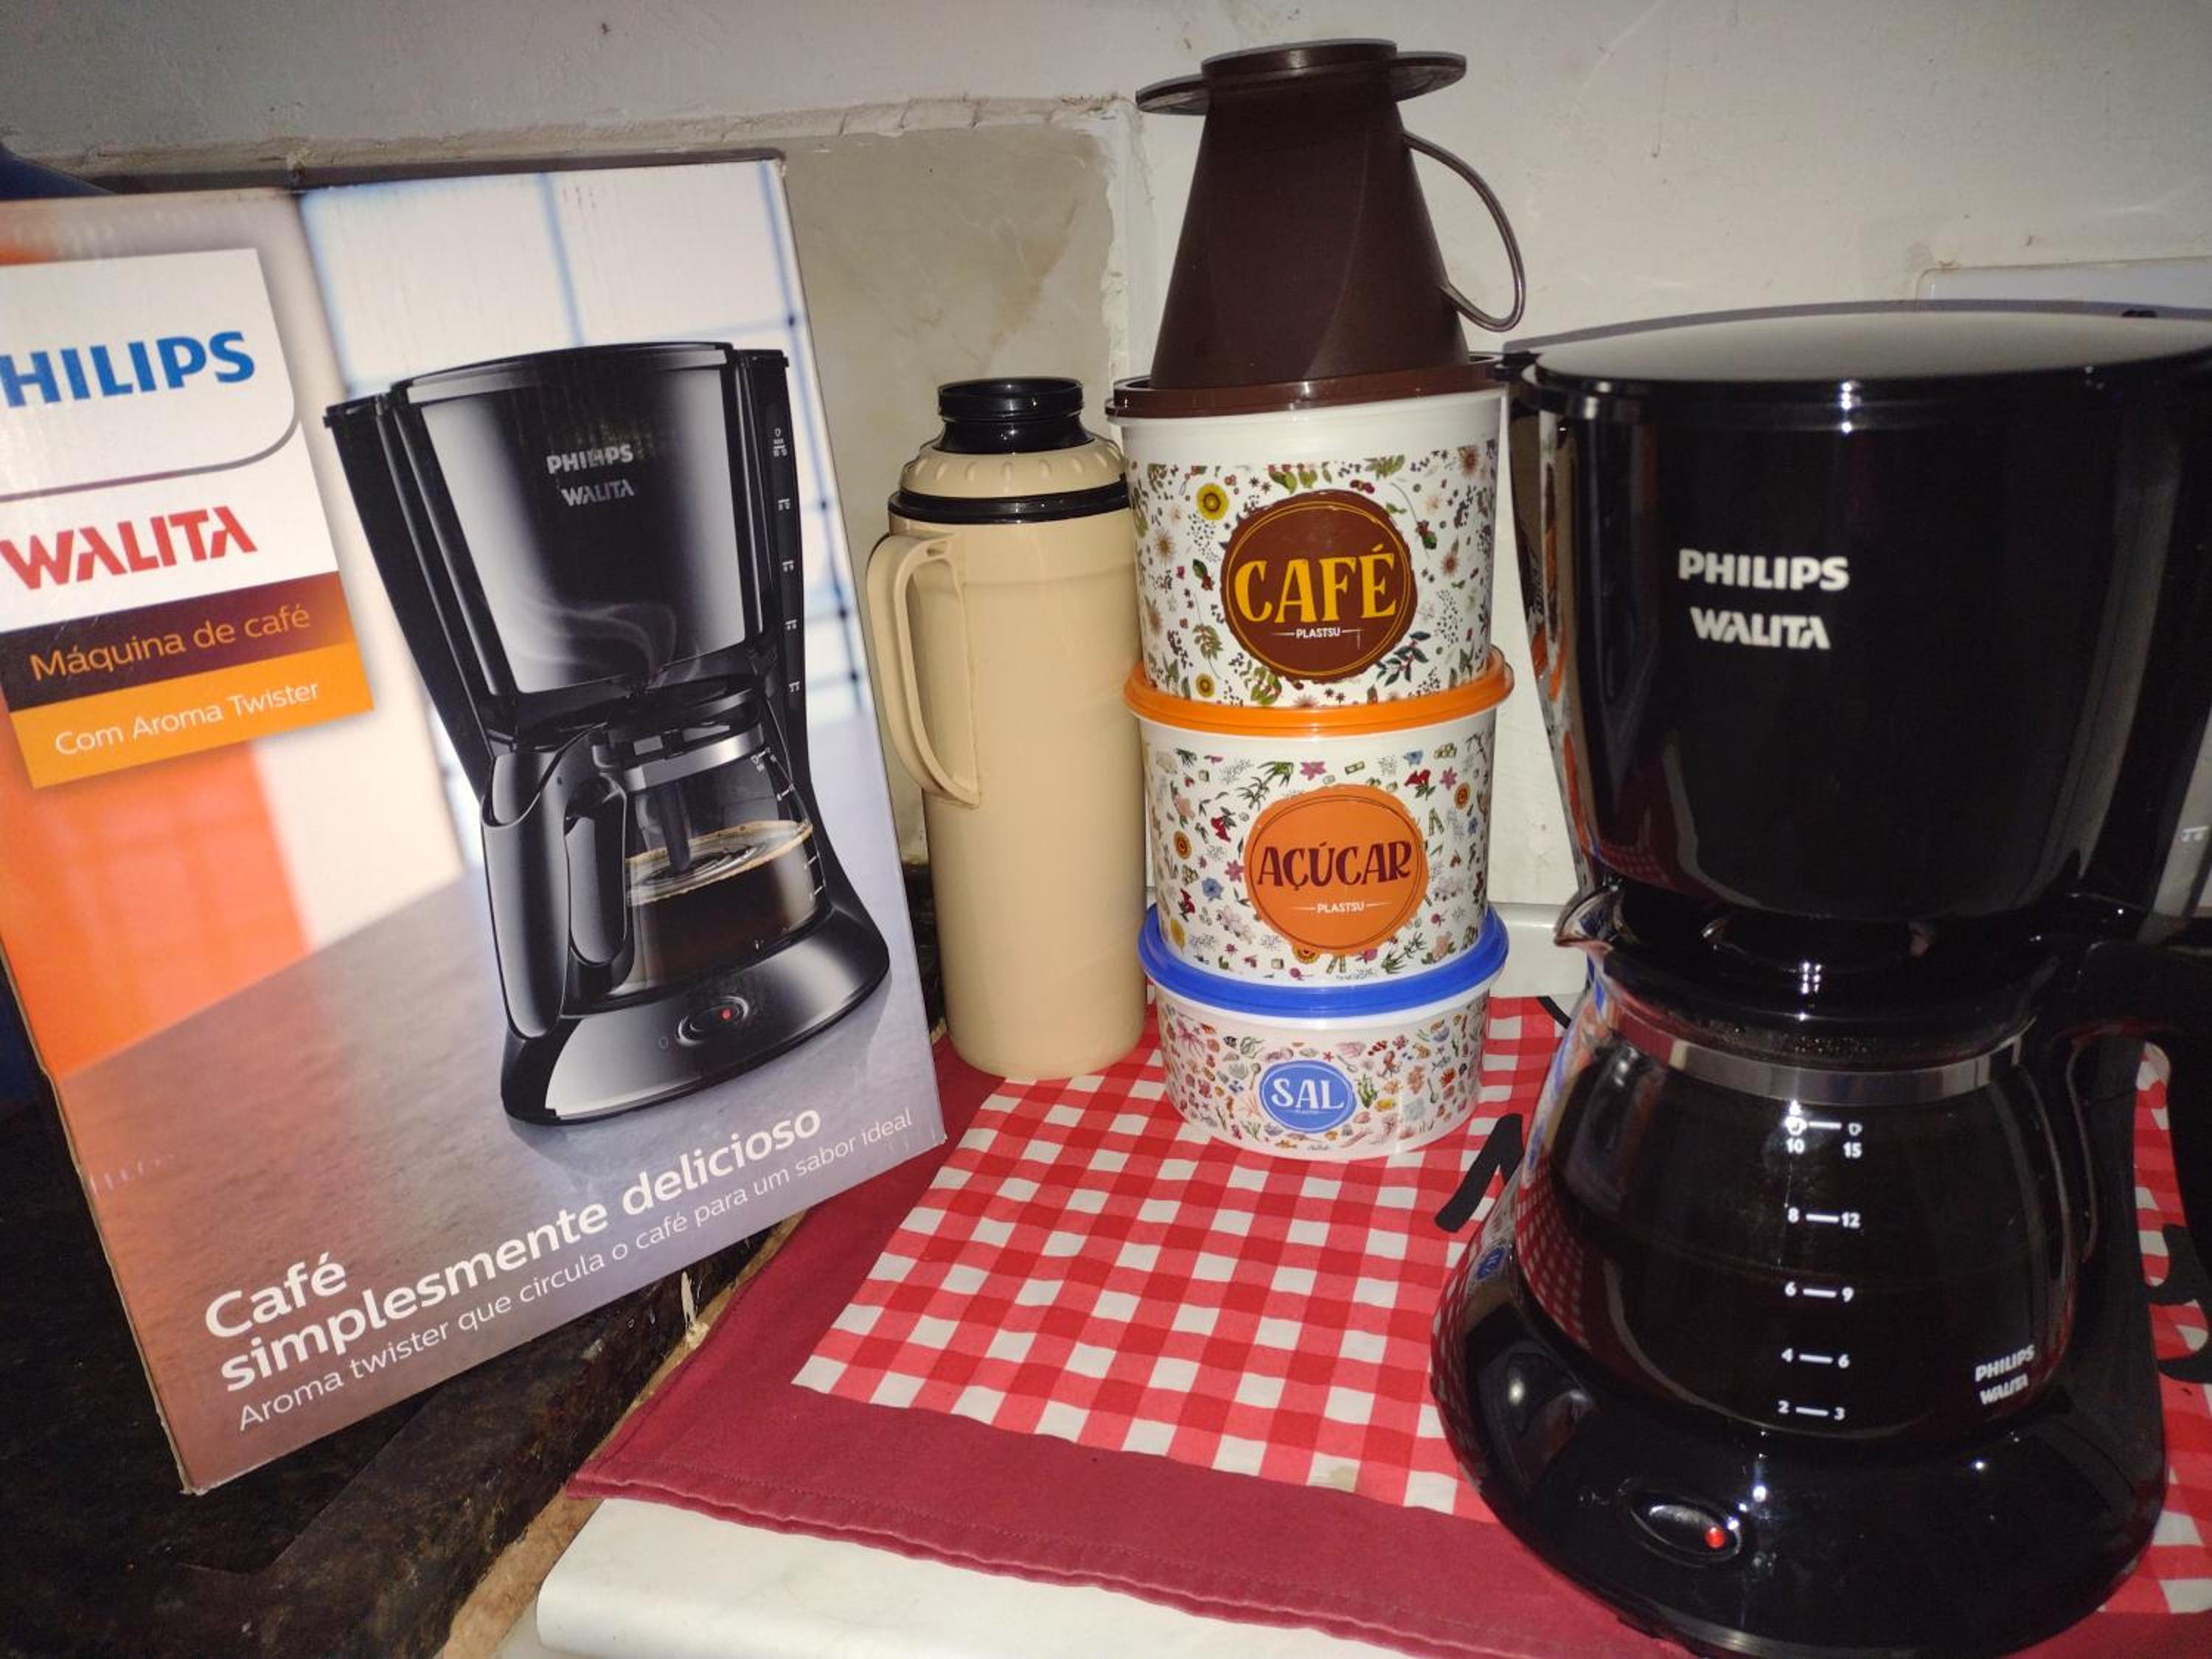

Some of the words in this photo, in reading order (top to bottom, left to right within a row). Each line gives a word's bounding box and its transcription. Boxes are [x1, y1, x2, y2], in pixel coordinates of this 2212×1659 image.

[546, 443, 634, 474] PHILIPS
[561, 479, 635, 507] WALITA
[0, 506, 257, 590] WALITA
[1234, 543, 1397, 623] CAFÉ
[1678, 548, 1850, 591] PHILIPS
[29, 632, 186, 681] Máquina
[192, 620, 237, 648] de
[244, 602, 311, 638] café
[1295, 627, 1341, 639] PLASTSU
[1690, 606, 1831, 650] WALITA
[55, 725, 124, 755] Com
[133, 703, 225, 740] Aroma
[229, 681, 319, 717] Twister
[1257, 840, 1412, 891] AÇÚCAR
[1317, 902, 1365, 914] PLASTSU
[1270, 1077, 1345, 1110] SAL
[1786, 1138, 1805, 1155] 10
[1843, 1141, 1863, 1158] 15
[1841, 1212, 1861, 1228] 12
[221, 1203, 609, 1392] simplesmente
[622, 1109, 821, 1216] delicioso
[239, 1370, 344, 1431] Aroma
[349, 1320, 449, 1380] twister
[458, 1293, 512, 1332] que
[520, 1252, 605, 1304] circula
[612, 1243, 628, 1260] o
[636, 1213, 687, 1249] café
[695, 1186, 748, 1228] para
[754, 1169, 790, 1197] um
[795, 1141, 856, 1176] sabor
[861, 1107, 913, 1146] ideal
[205, 1251, 347, 1338] Café
[1784, 1281, 1797, 1297] 6
[1842, 1287, 1854, 1303] 9
[1838, 1354, 1850, 1368] 6
[1975, 1344, 2035, 1382] PHILIPS
[1778, 1400, 1790, 1414] 2
[1834, 1407, 1846, 1421] 3
